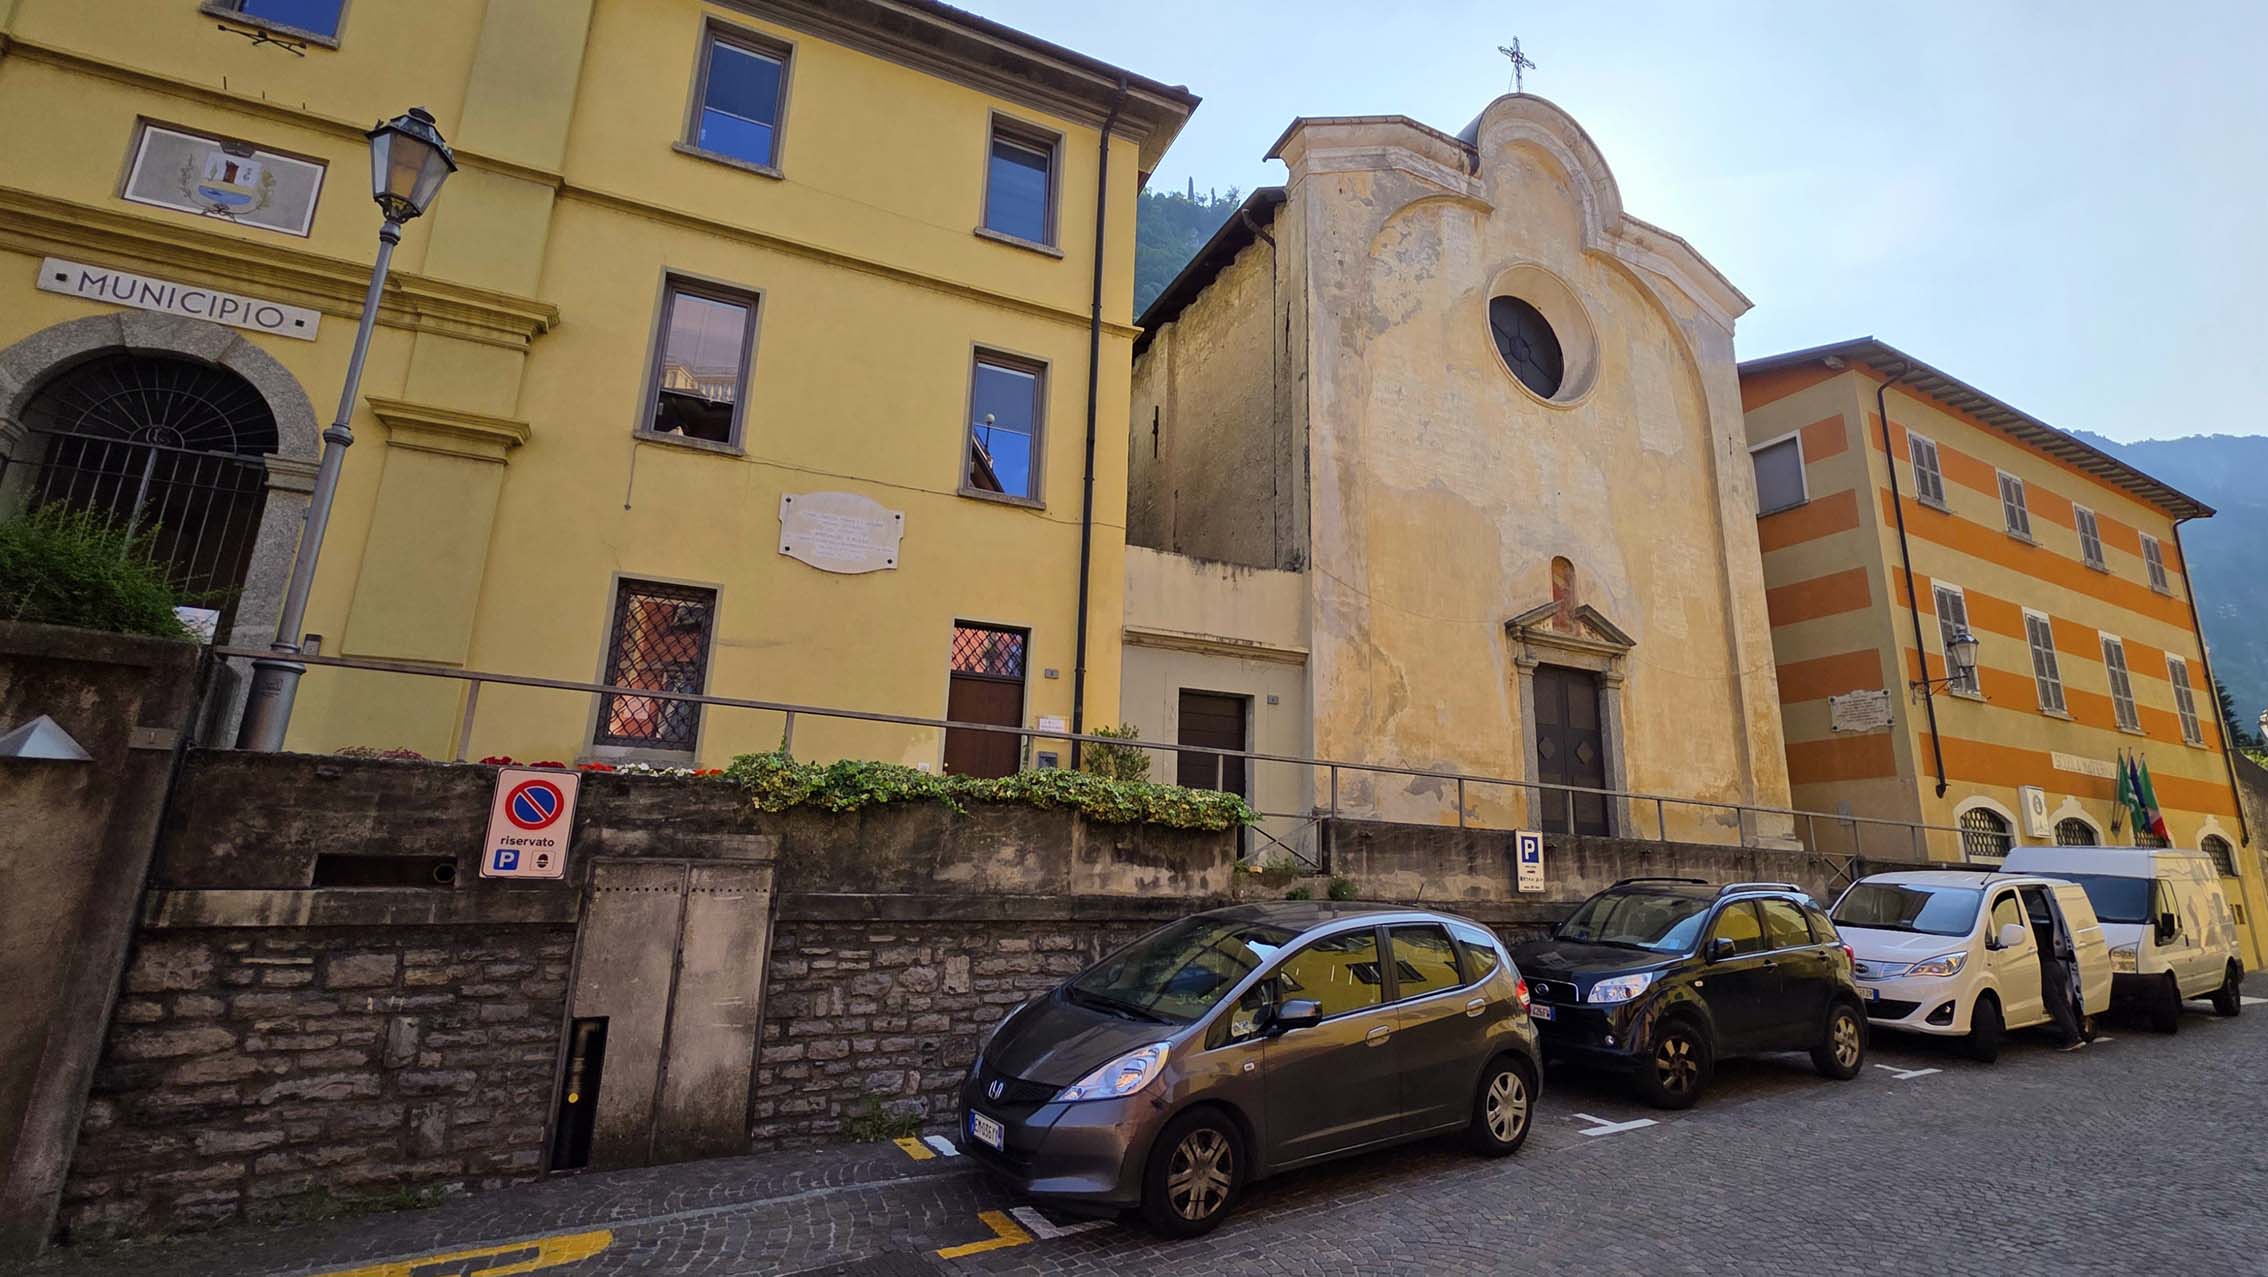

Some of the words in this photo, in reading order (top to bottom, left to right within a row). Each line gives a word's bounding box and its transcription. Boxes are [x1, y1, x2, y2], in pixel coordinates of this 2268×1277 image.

[77, 270, 285, 329] MUNICIPIO
[499, 835, 555, 848] riservato
[1524, 839, 1536, 860] P
[498, 851, 515, 868] P
